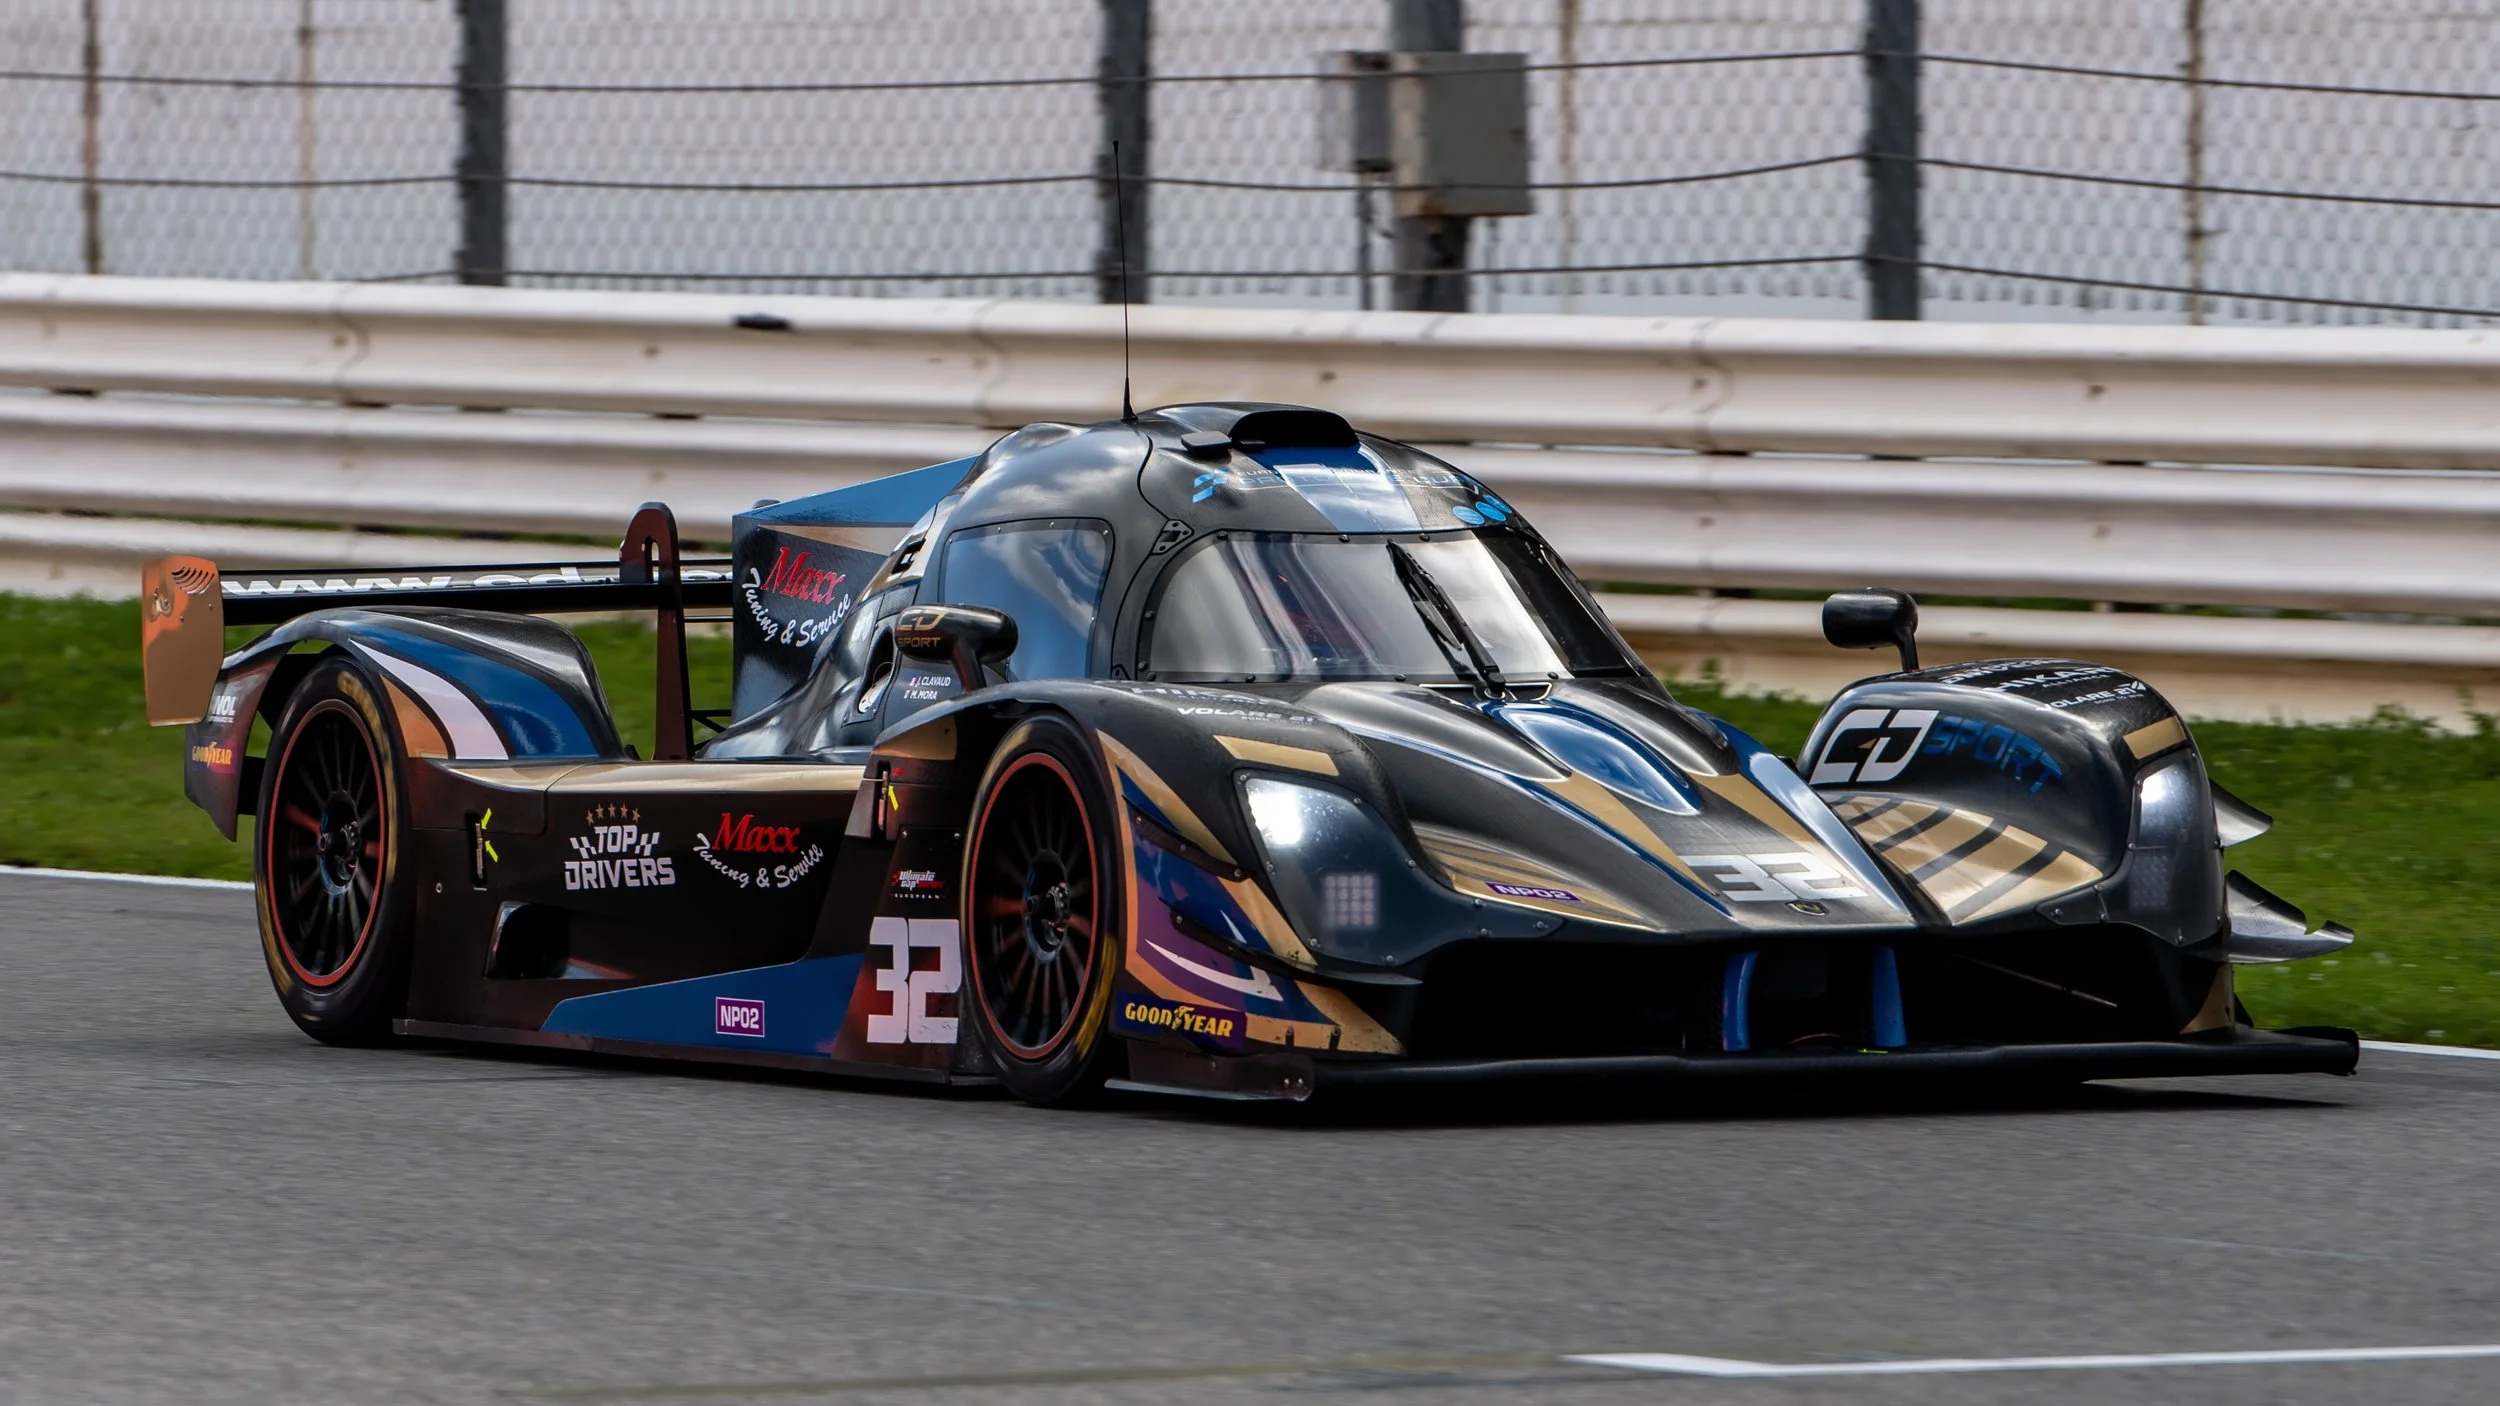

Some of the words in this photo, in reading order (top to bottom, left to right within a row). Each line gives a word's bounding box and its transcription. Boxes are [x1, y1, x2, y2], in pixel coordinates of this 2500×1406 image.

[760, 546, 846, 605] Maxx
[741, 567, 778, 641] Tuning
[780, 619, 797, 644] &
[795, 593, 851, 647] Service
[897, 636, 941, 648] SPORT
[1177, 707, 1282, 719] VOLARE
[2035, 690, 2113, 713] VOLARE
[1923, 715, 2063, 793] SPORT
[594, 824, 638, 854] TOP
[712, 812, 800, 854] Maxx
[564, 857, 676, 890] DRIVERS
[692, 832, 750, 889] Tuning
[755, 867, 770, 888] &
[773, 844, 824, 889] Service
[1678, 851, 1869, 901] 32
[866, 916, 963, 1044] 32
[1124, 1001, 1234, 1037] GOODYEAR
